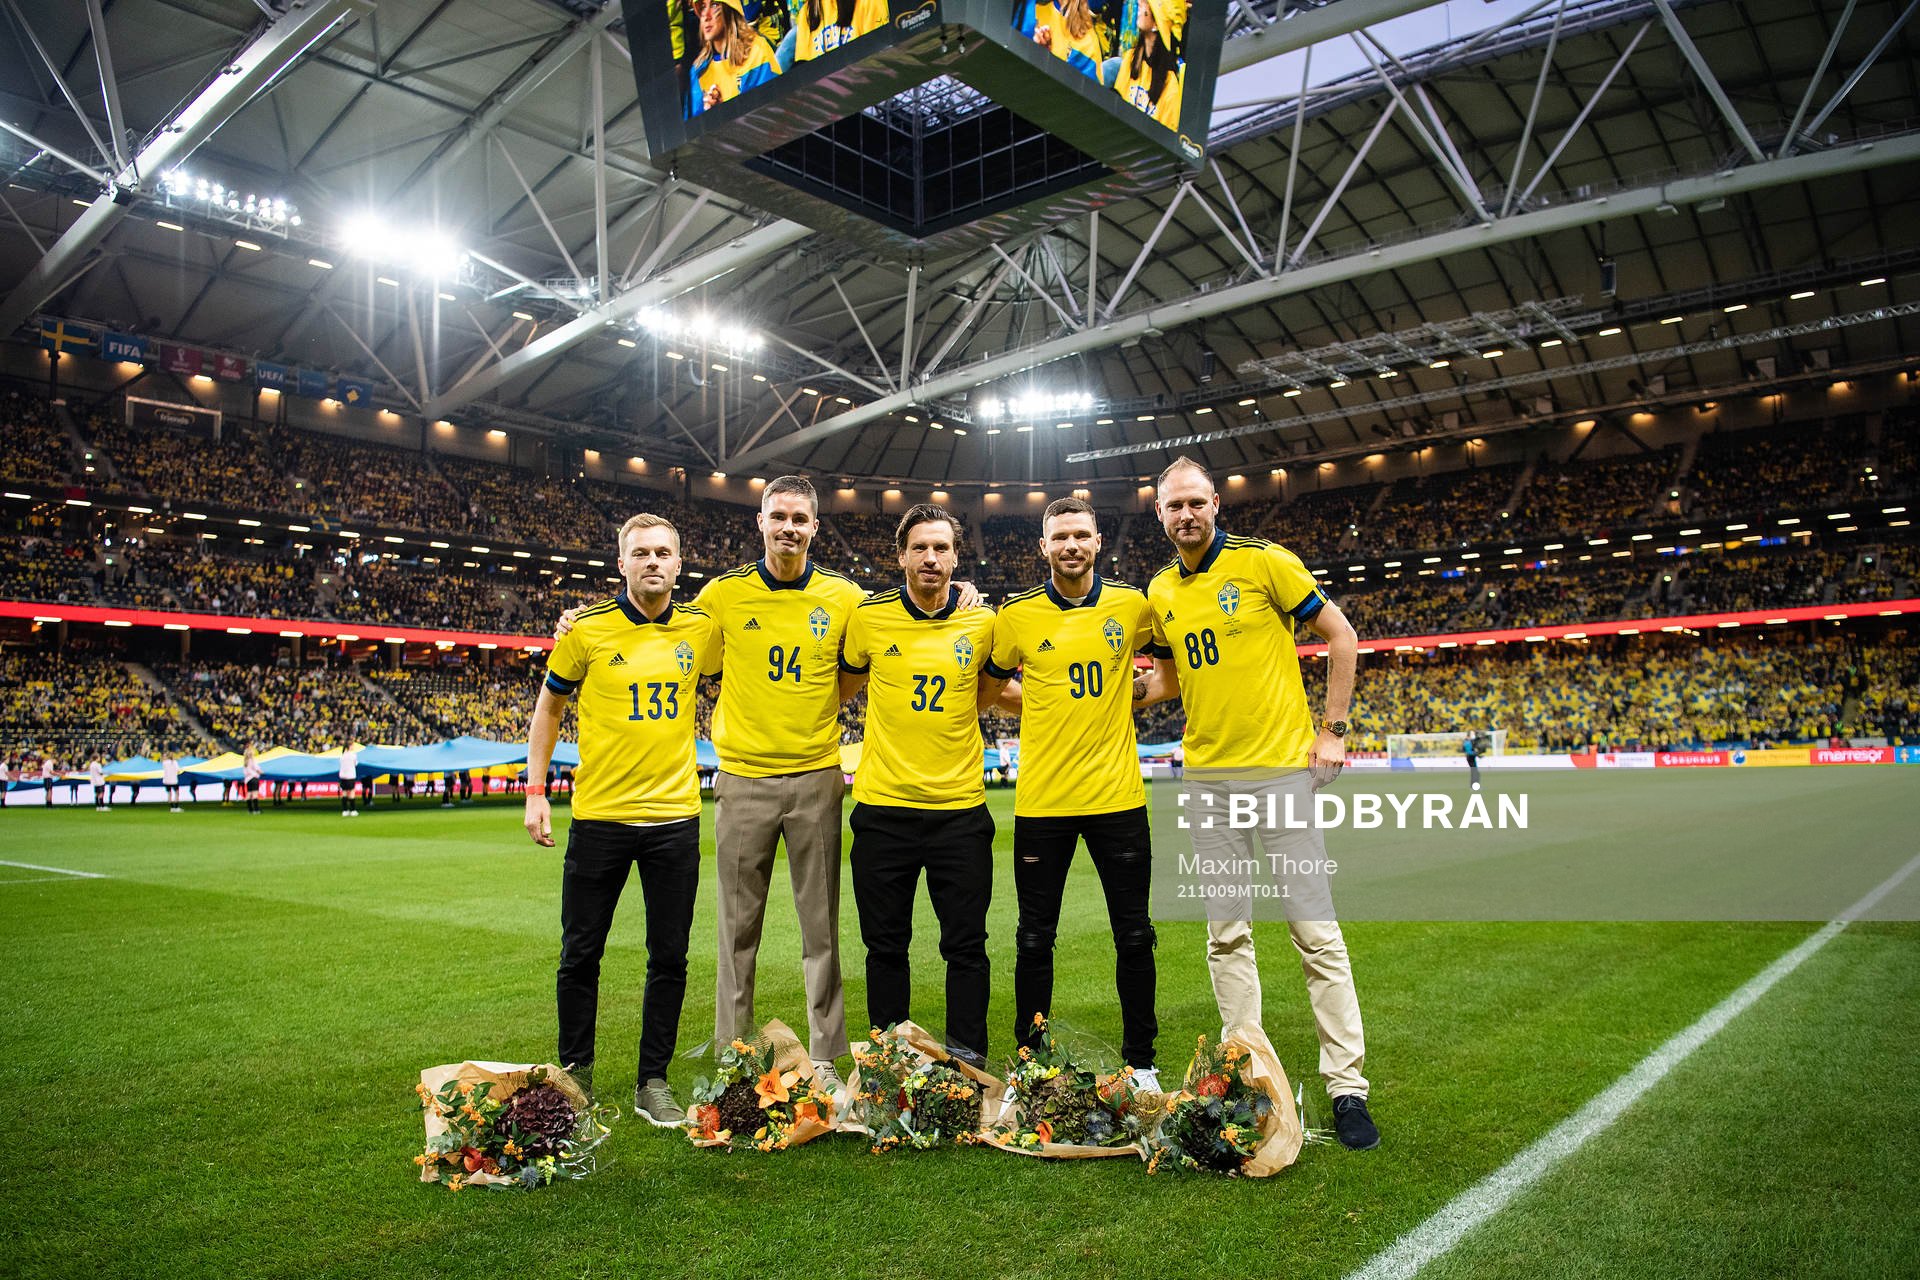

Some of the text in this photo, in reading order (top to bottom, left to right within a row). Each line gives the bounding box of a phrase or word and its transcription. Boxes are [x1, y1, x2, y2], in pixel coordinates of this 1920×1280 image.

[108, 342, 141, 358] FIFA
[258, 369, 284, 382] UEFA
[768, 645, 802, 683] 94
[1184, 628, 1220, 670] 88
[911, 674, 946, 712] 32
[1068, 660, 1103, 699] 90
[628, 682, 679, 721] 133
